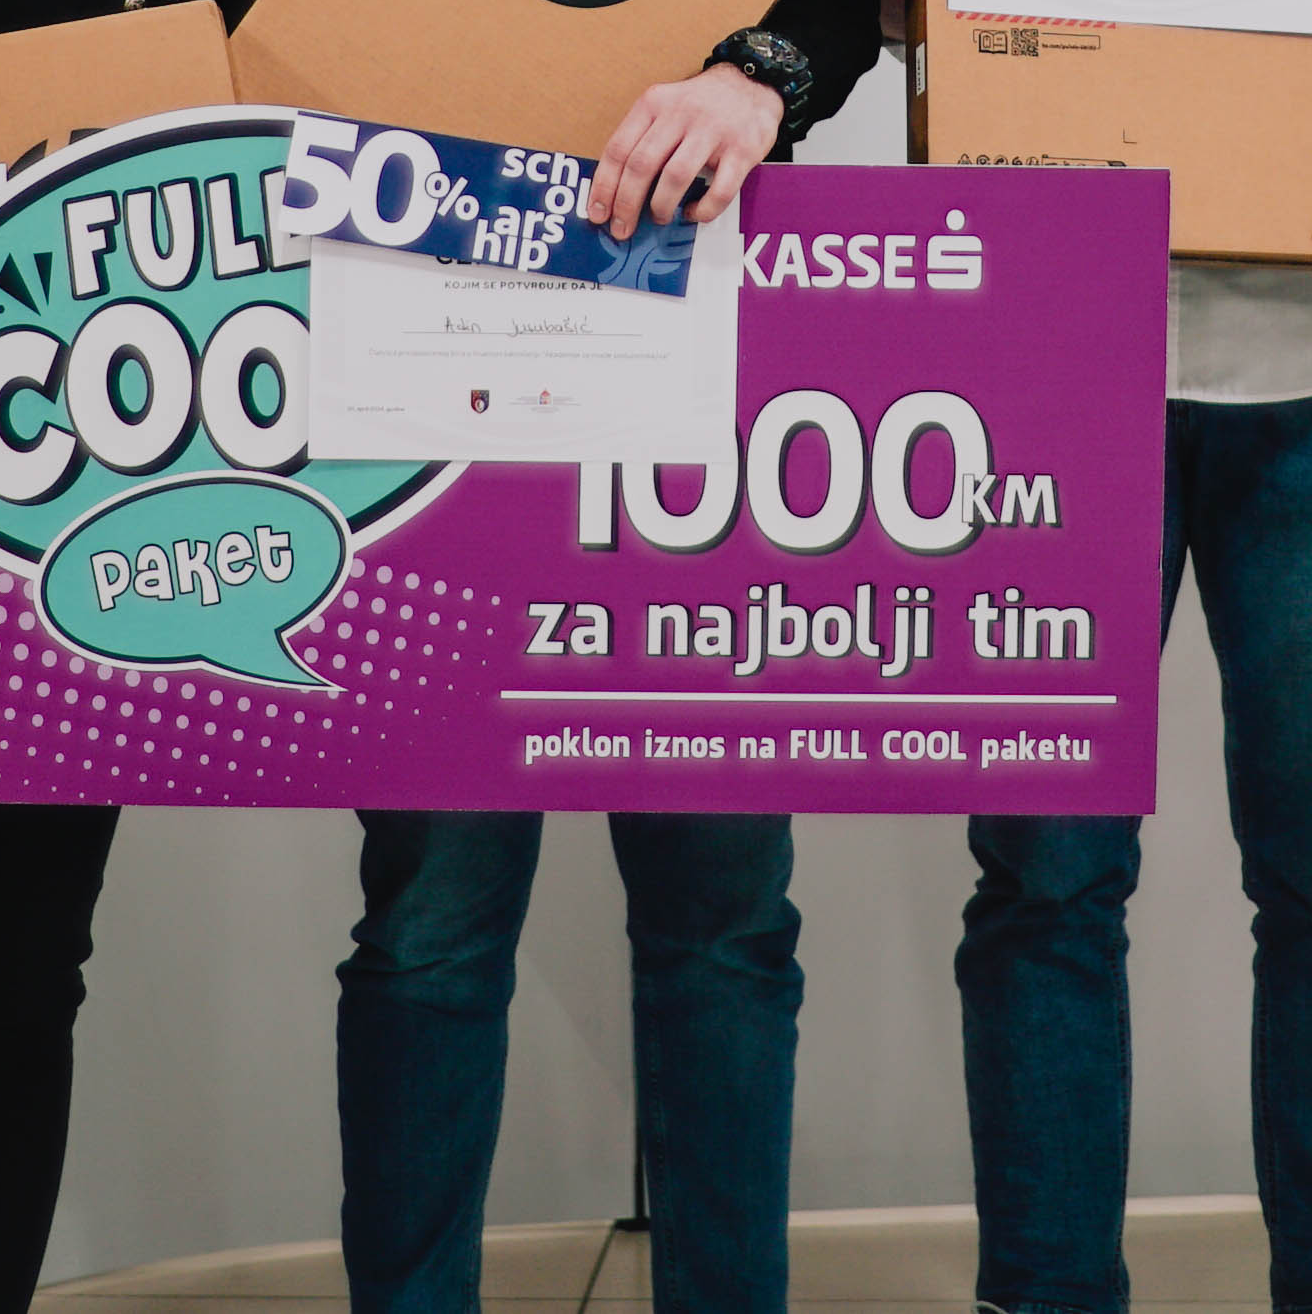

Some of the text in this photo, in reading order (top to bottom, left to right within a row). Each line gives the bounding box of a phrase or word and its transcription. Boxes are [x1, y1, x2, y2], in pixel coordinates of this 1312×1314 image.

[278, 111, 480, 247] 50%
[500, 146, 580, 188] sch
[472, 218, 550, 273] hip
[493, 202, 566, 246] ars
[444, 280, 480, 291] KOJIM
[483, 280, 498, 291] SE
[570, 281, 587, 291] DA
[89, 524, 295, 612] paket
[524, 580, 1096, 679] za najbolji tim
[523, 726, 1092, 771] poklon iznos na FULL COOL paketu
